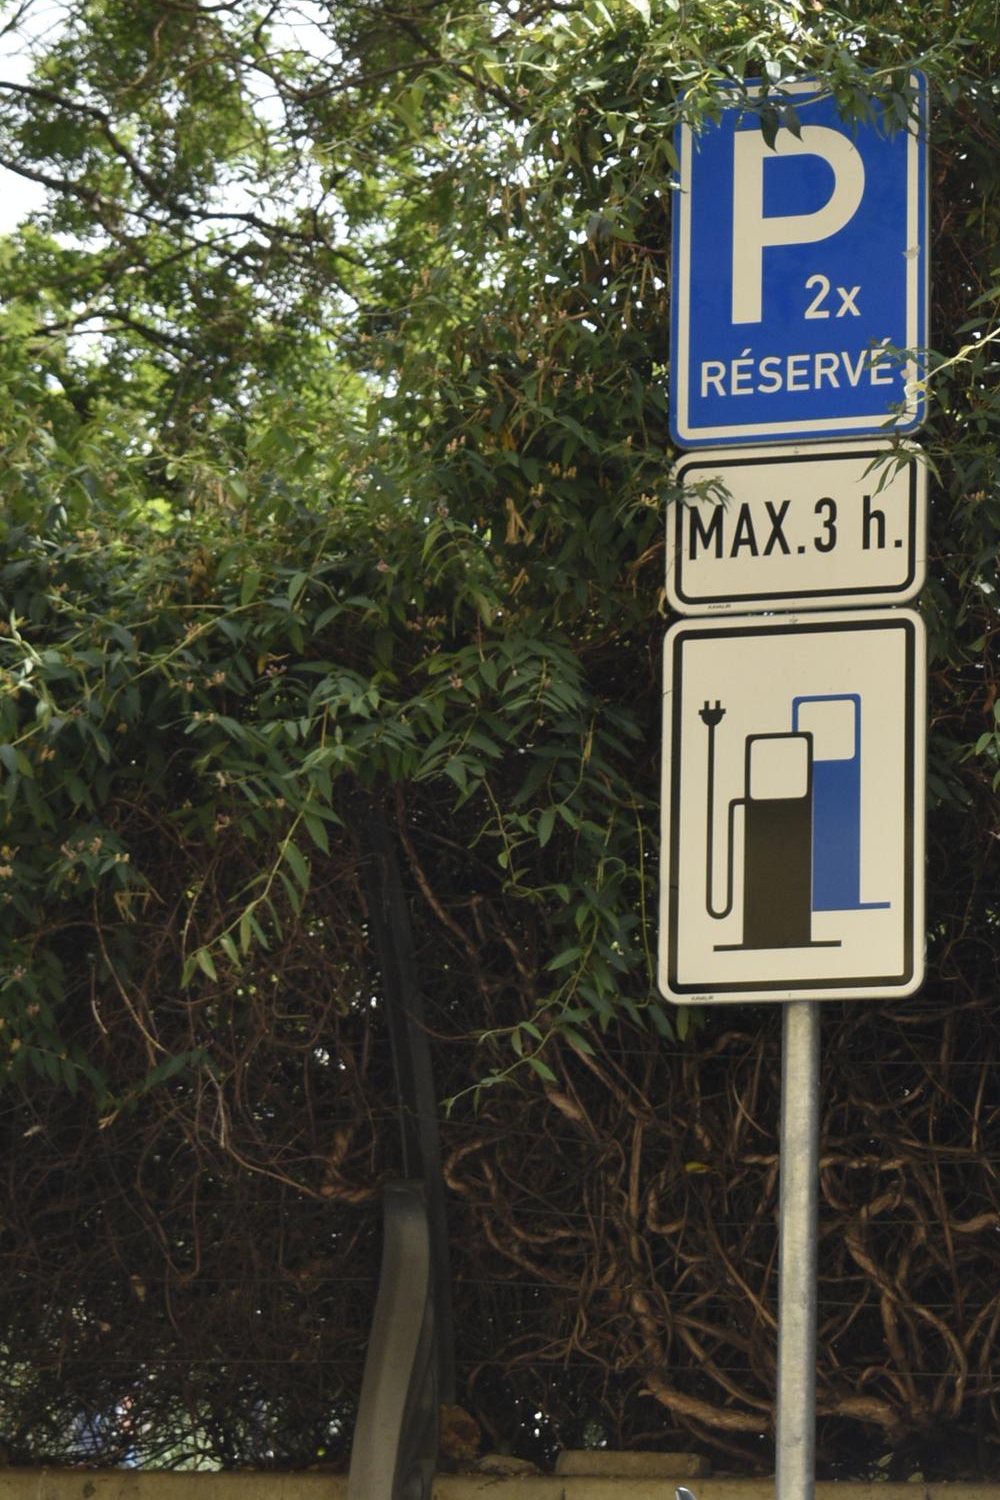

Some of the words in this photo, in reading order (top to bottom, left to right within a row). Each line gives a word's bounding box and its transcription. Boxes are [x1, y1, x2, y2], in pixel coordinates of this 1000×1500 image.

[732, 126, 865, 324] P
[804, 274, 861, 319] 2x
[701, 338, 894, 397] RÉSERVÉ
[862, 495, 903, 549] h.
